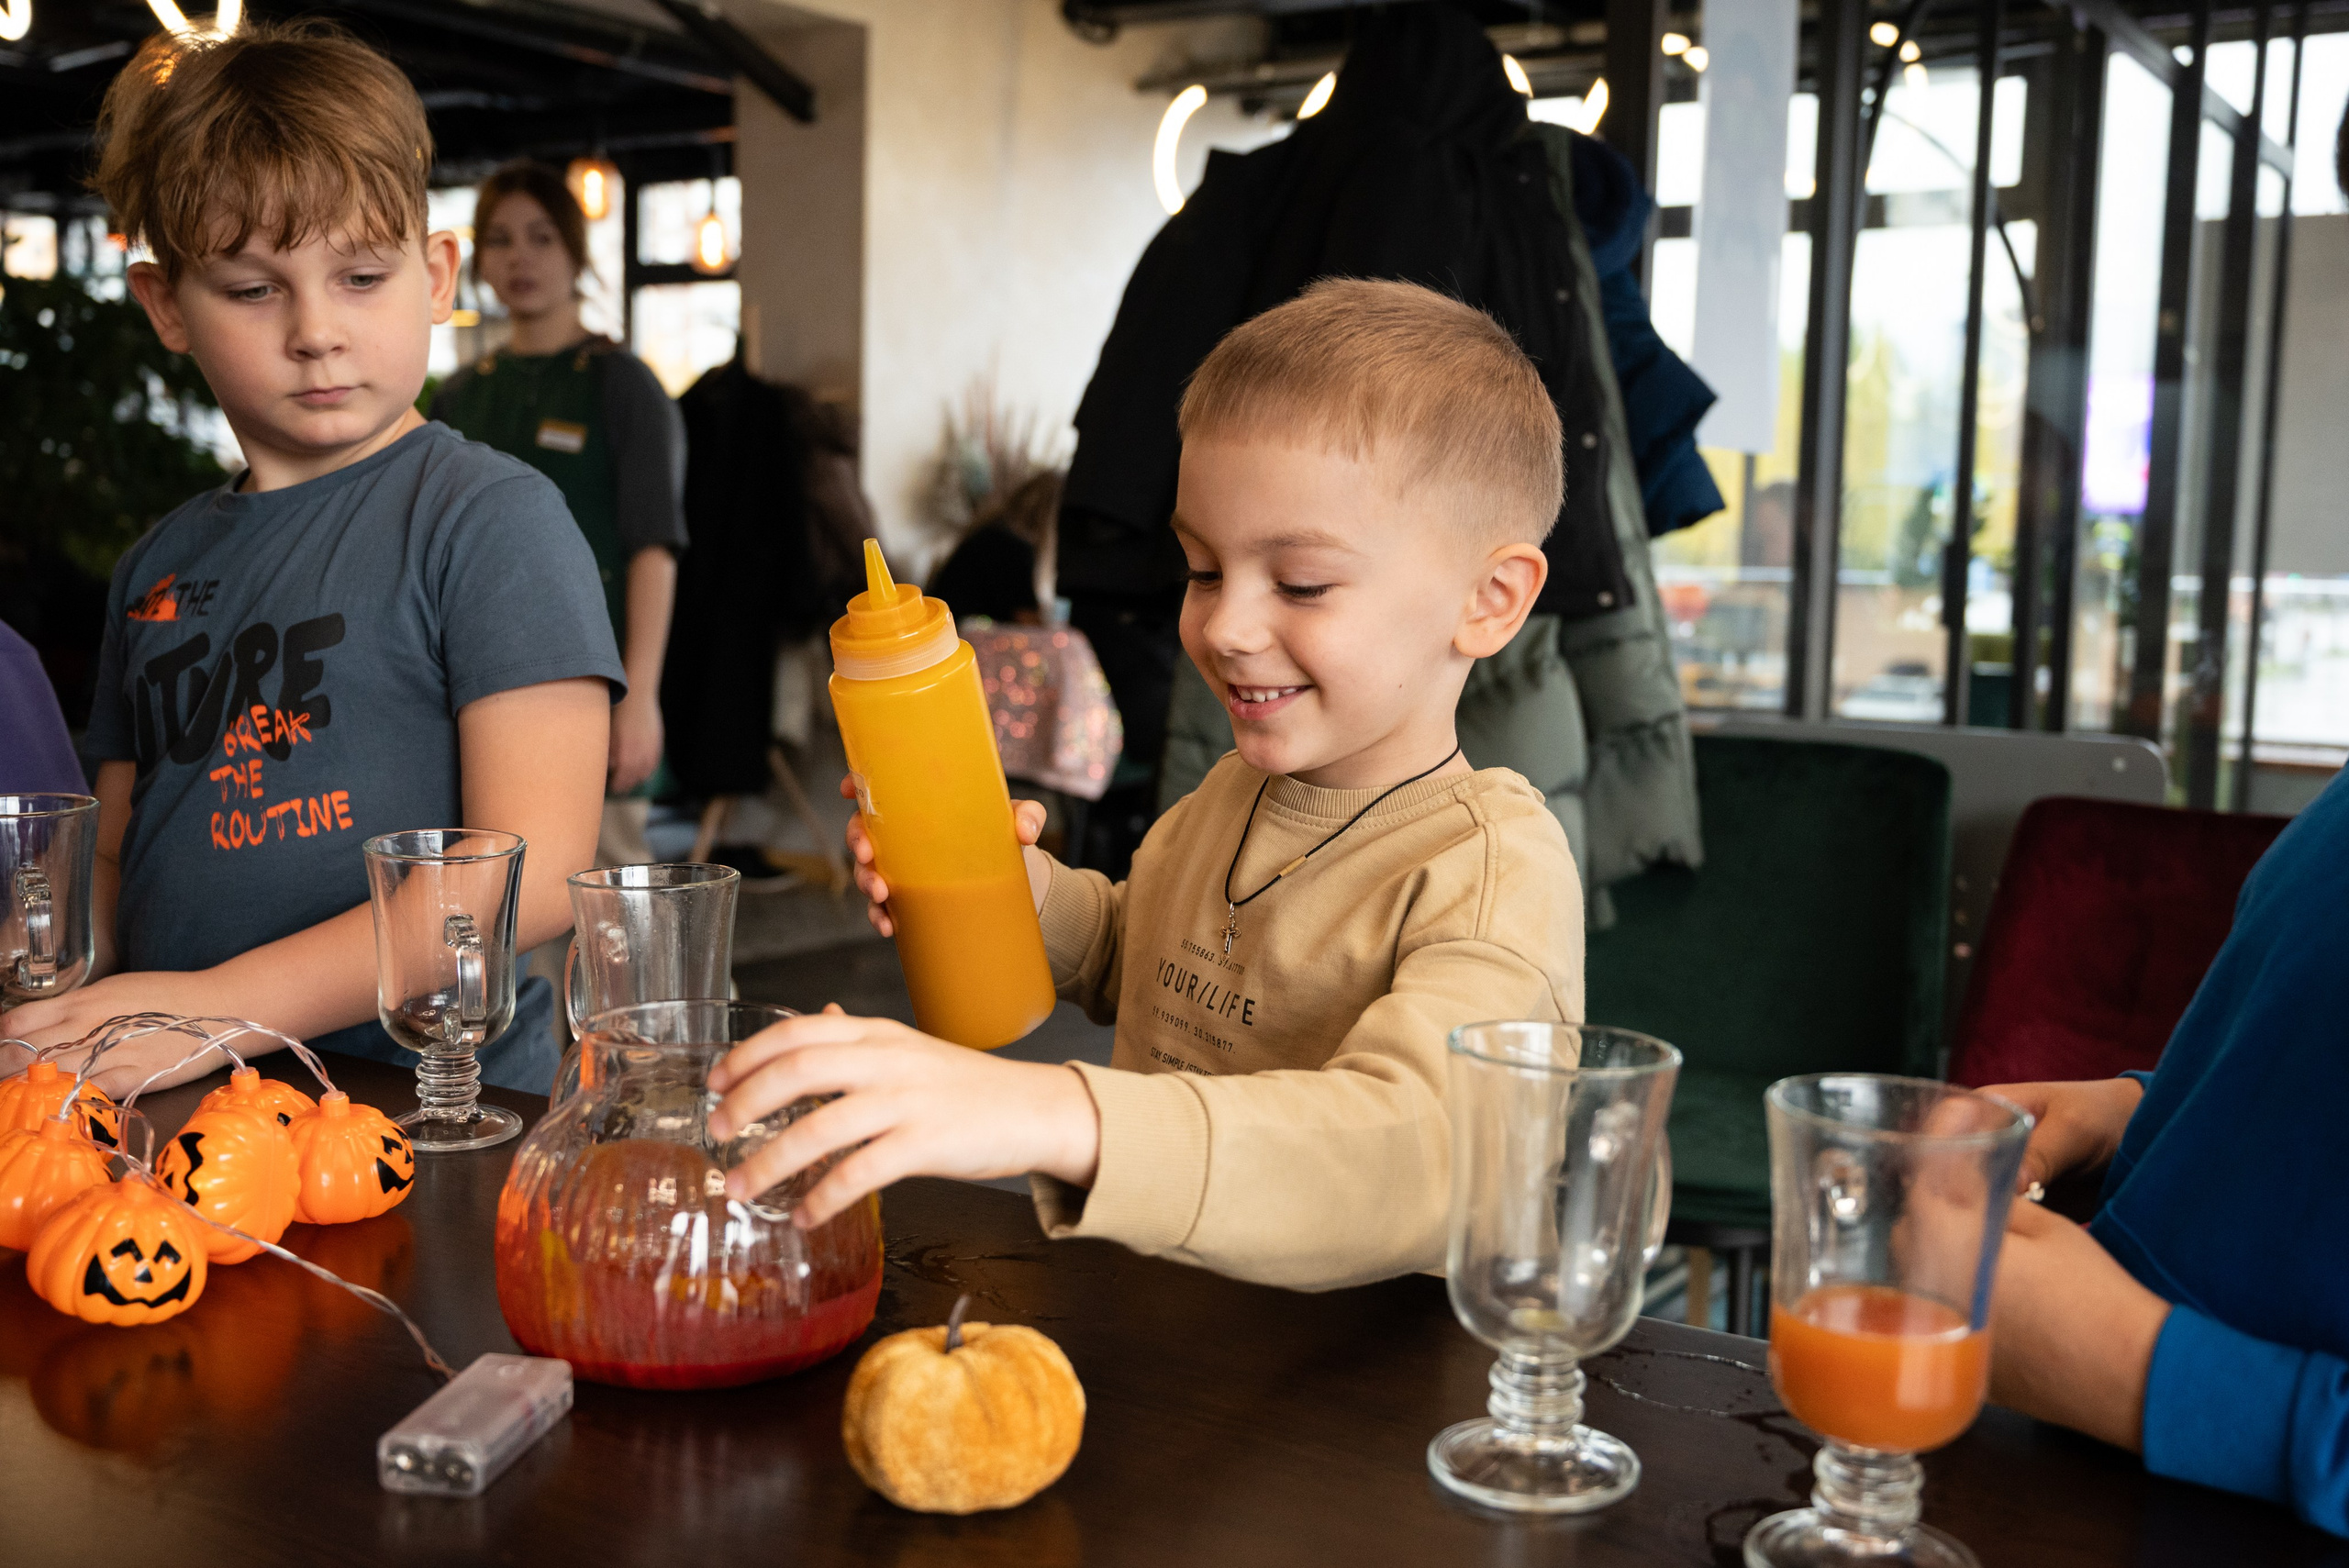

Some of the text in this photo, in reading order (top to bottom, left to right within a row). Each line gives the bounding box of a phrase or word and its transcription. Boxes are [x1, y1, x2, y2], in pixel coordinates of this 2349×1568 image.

[174, 579, 220, 617] THE
[224, 704, 312, 758] BREAK
[209, 758, 264, 804] THE
[210, 789, 354, 851] ROUTINE
[1156, 957, 1256, 1027] YOUR/LIFE
[1150, 1046, 1163, 1062] STAY
[1162, 1052, 1186, 1072] SIMPLE
